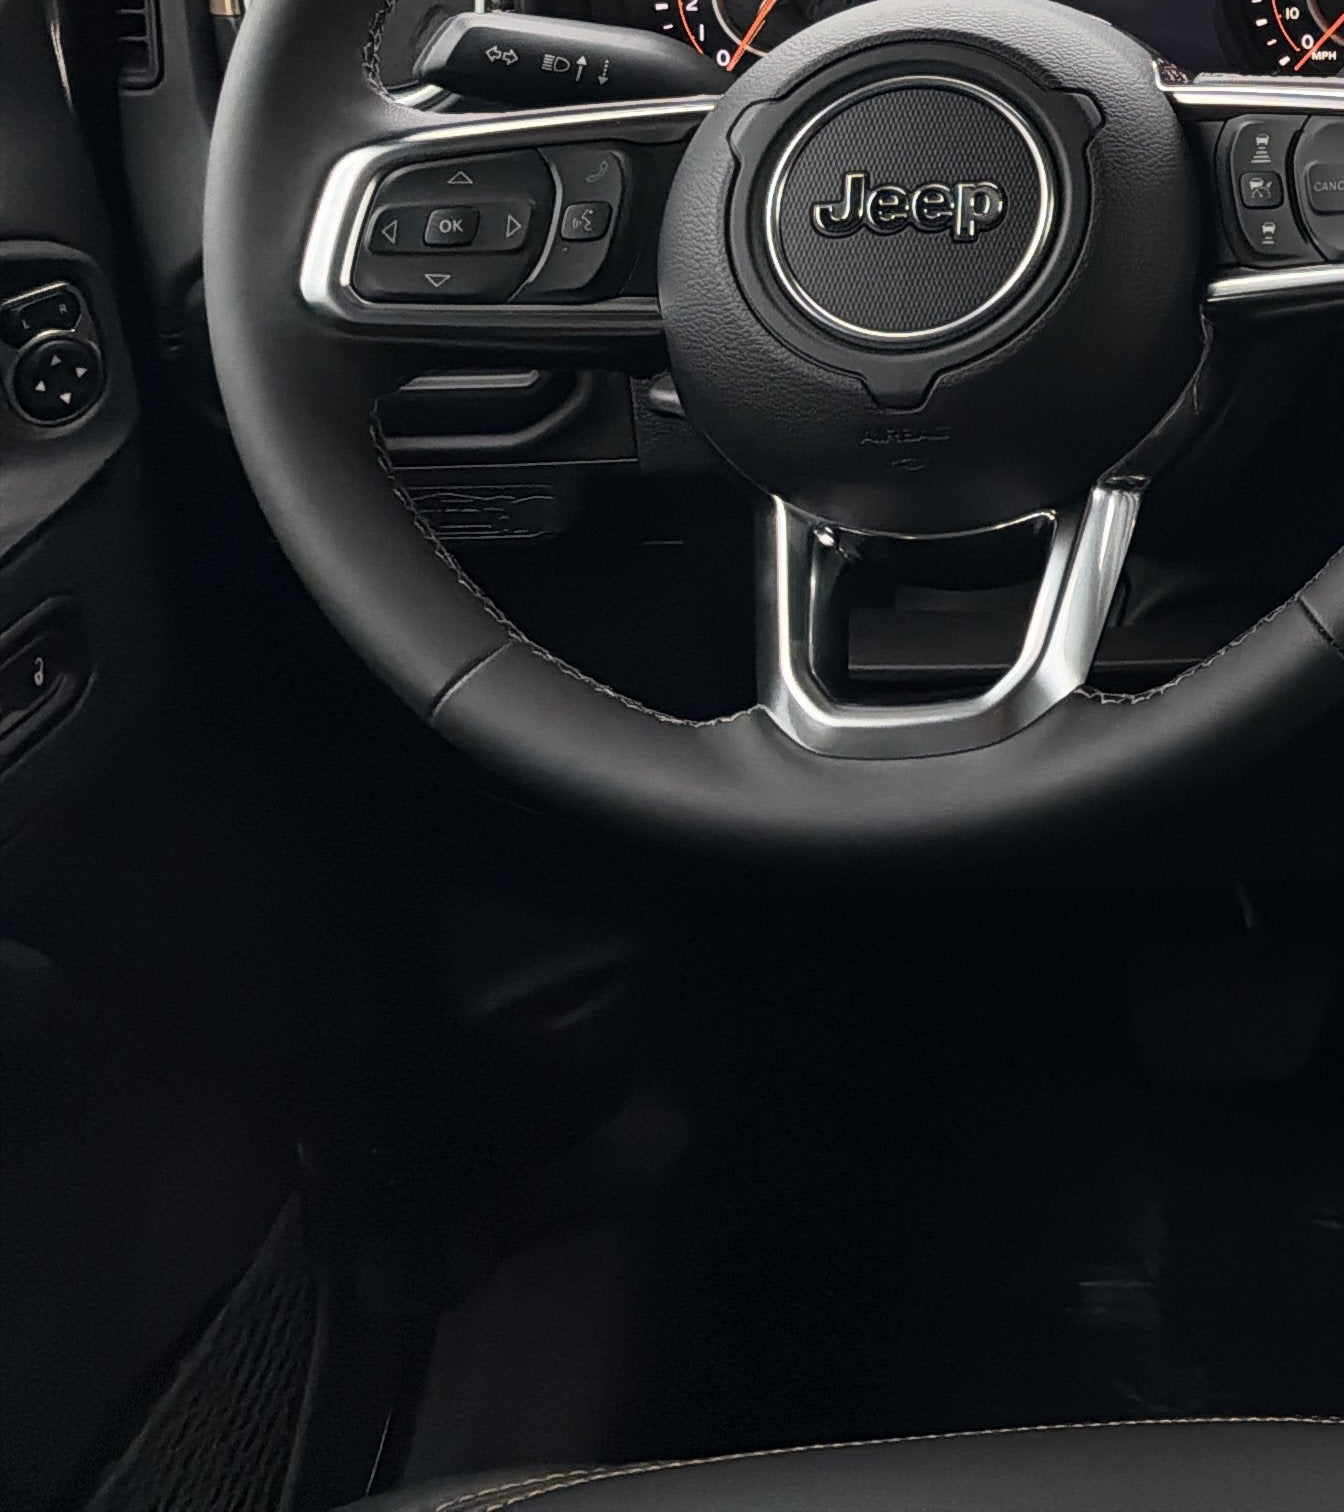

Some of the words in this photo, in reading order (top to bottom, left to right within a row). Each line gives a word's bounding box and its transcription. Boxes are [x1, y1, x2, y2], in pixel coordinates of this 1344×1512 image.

[1285, 6, 1300, 21] 10
[1301, 33, 1315, 50] 0
[716, 49, 731, 67] 0
[1311, 51, 1337, 61] MPH
[1314, 180, 1344, 193] CANC
[812, 172, 1006, 244] Jeep
[439, 219, 464, 234] OK
